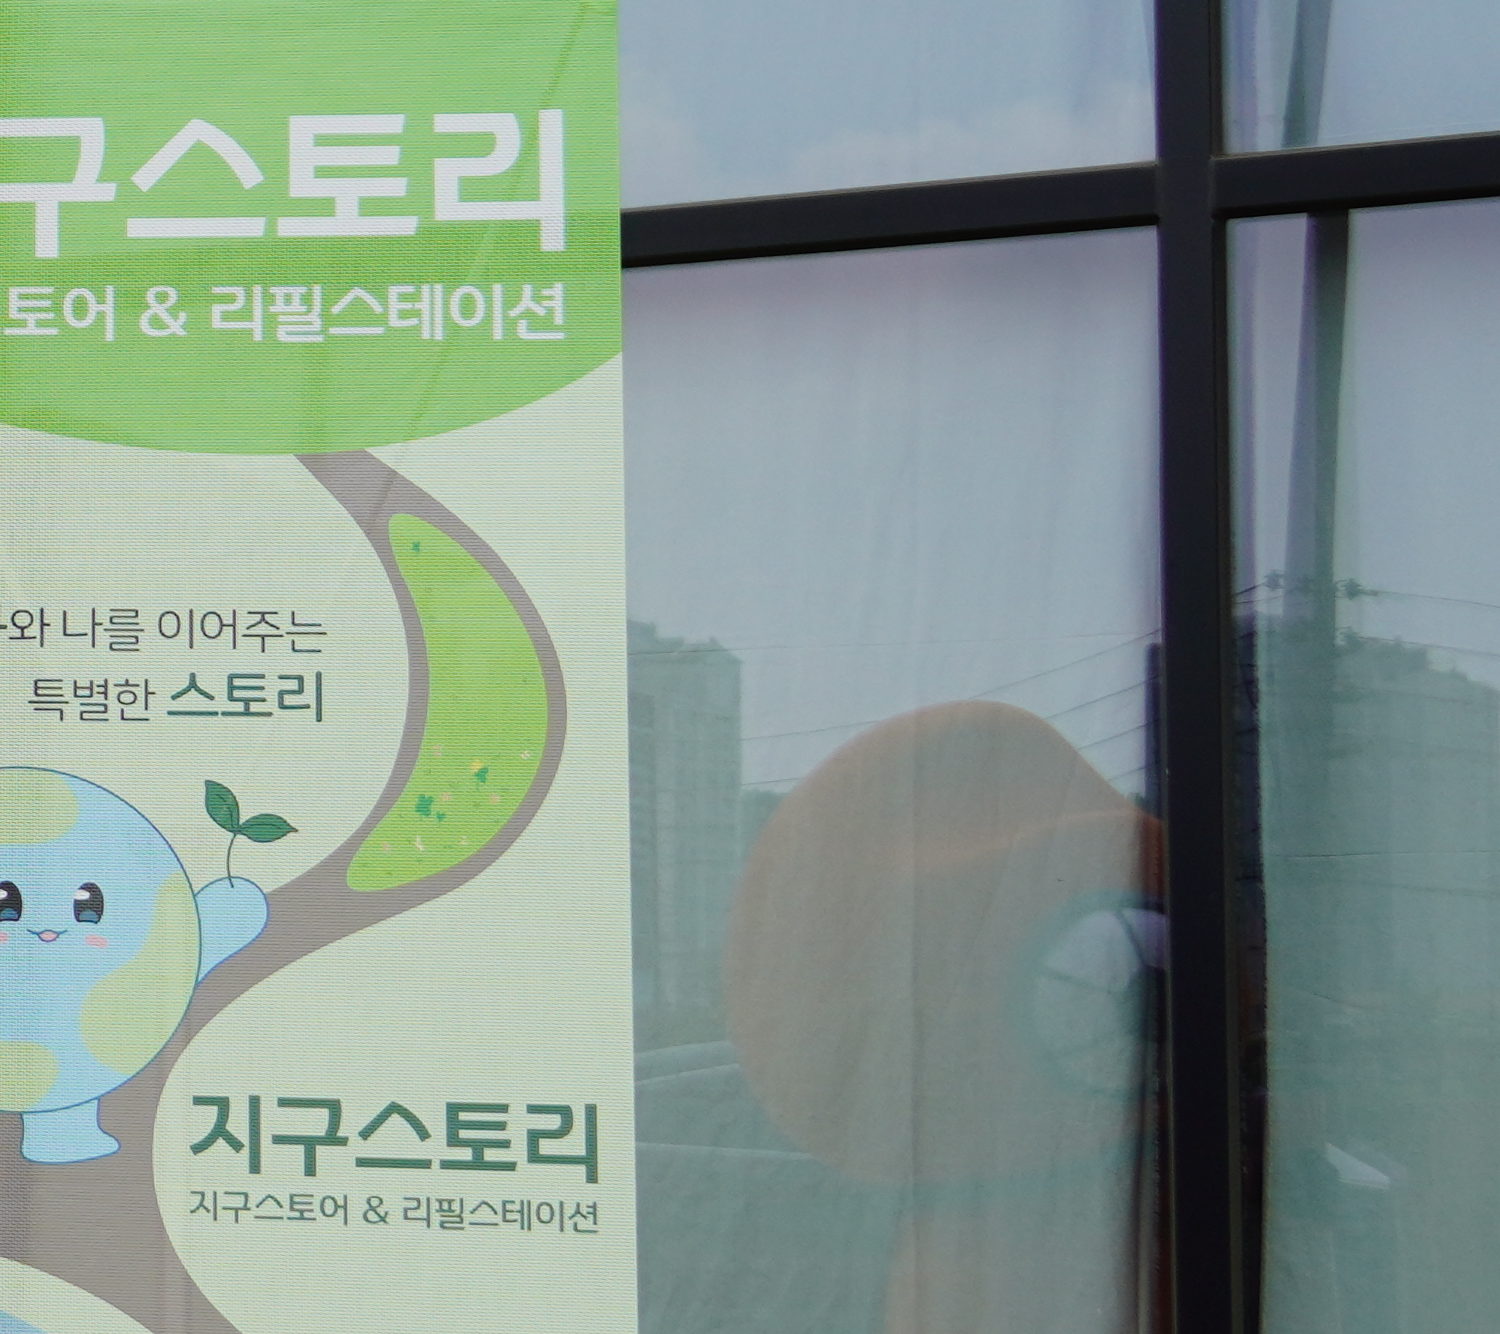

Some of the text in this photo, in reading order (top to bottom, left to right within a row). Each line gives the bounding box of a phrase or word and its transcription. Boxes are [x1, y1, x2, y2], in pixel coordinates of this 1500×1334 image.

[138, 285, 190, 337] &
[209, 282, 568, 342] 리필스테이션
[62, 606, 145, 652] 나를
[157, 607, 328, 654] 이어주는
[28, 670, 325, 724] 특별한 스토리
[189, 1093, 600, 1184] 지구스토리
[189, 1189, 600, 1235] 지구스토어 & 리필스테이션
